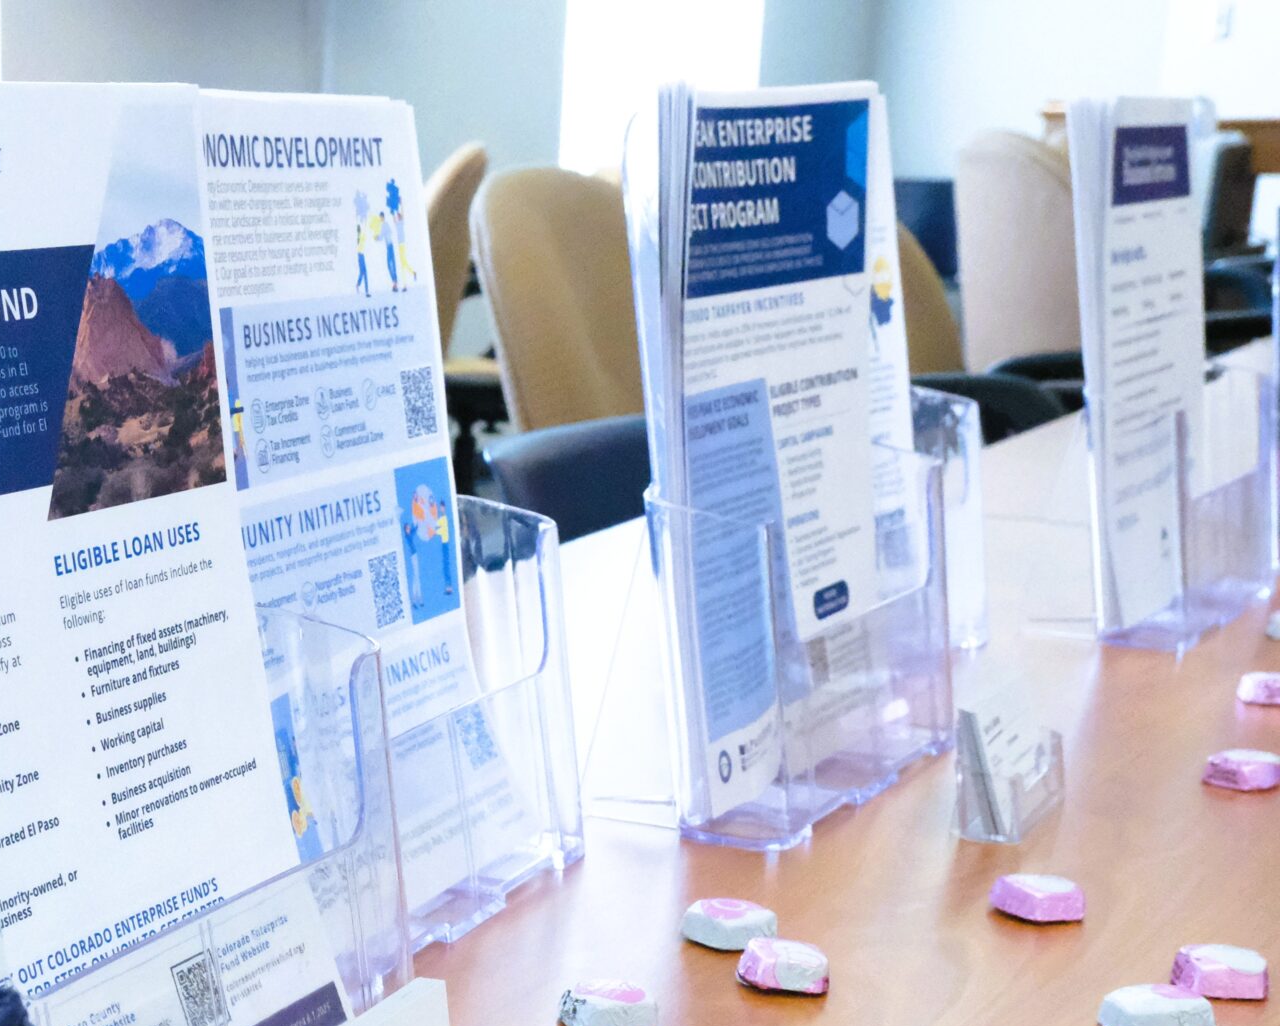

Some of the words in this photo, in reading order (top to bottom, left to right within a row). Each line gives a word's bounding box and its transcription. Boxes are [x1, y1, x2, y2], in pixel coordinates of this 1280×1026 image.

[718, 115, 813, 148] ENTERPRISE
[203, 133, 261, 168] NOMIC
[263, 136, 383, 169] DEVELOPMENT
[710, 197, 780, 230] PROGRAM
[243, 316, 313, 349] BUSINESS
[316, 305, 400, 338] INCENTIVES
[8, 347, 18, 358] to
[8, 367, 17, 377] in
[19, 362, 28, 376] El
[9, 383, 39, 397] access
[40, 401, 48, 411] is
[22, 420, 35, 433] for
[38, 418, 47, 431] El
[241, 513, 293, 551] UNITY
[298, 490, 382, 534] INITIATIVES
[54, 541, 120, 576] ELIGIBLE
[123, 531, 163, 558] LOAN
[167, 522, 200, 547] USES
[59, 590, 91, 610] Eligible
[93, 586, 113, 600] uses
[114, 579, 123, 594] of
[125, 578, 143, 591] loan
[145, 569, 168, 584] funds
[170, 561, 198, 578] include
[199, 559, 212, 570] the
[63, 610, 105, 630] following:
[84, 641, 125, 661] Financing
[126, 634, 134, 648] of
[136, 628, 157, 645] fixed
[158, 623, 183, 639] assets
[184, 610, 228, 633] (machinery,
[12, 655, 21, 667] at
[87, 653, 135, 676] equipment,
[136, 644, 157, 661] land,
[157, 632, 196, 654] buildings)
[385, 641, 451, 687] INANCING
[90, 676, 130, 696] Furniture
[132, 668, 147, 684] and
[148, 660, 179, 678] fixtures
[95, 703, 132, 724] Business
[133, 692, 166, 712] supplies
[100, 730, 136, 751] Working
[136, 717, 164, 738] capital
[105, 755, 145, 778] Inventory
[147, 739, 187, 765] purchases
[16, 768, 40, 788] Zone
[111, 782, 147, 804] Business
[148, 765, 191, 790] acquisition
[115, 807, 139, 825] Minor
[141, 788, 188, 815] renovations
[189, 784, 198, 795] to
[199, 757, 256, 791] owner-occupied
[26, 822, 37, 837] El
[38, 816, 61, 834] Paso
[118, 818, 153, 840] facilities
[18, 959, 43, 984] OUT
[47, 928, 112, 970] COLORADO
[114, 896, 179, 938] ENTERPRISE
[180, 877, 217, 906] FUND'S
